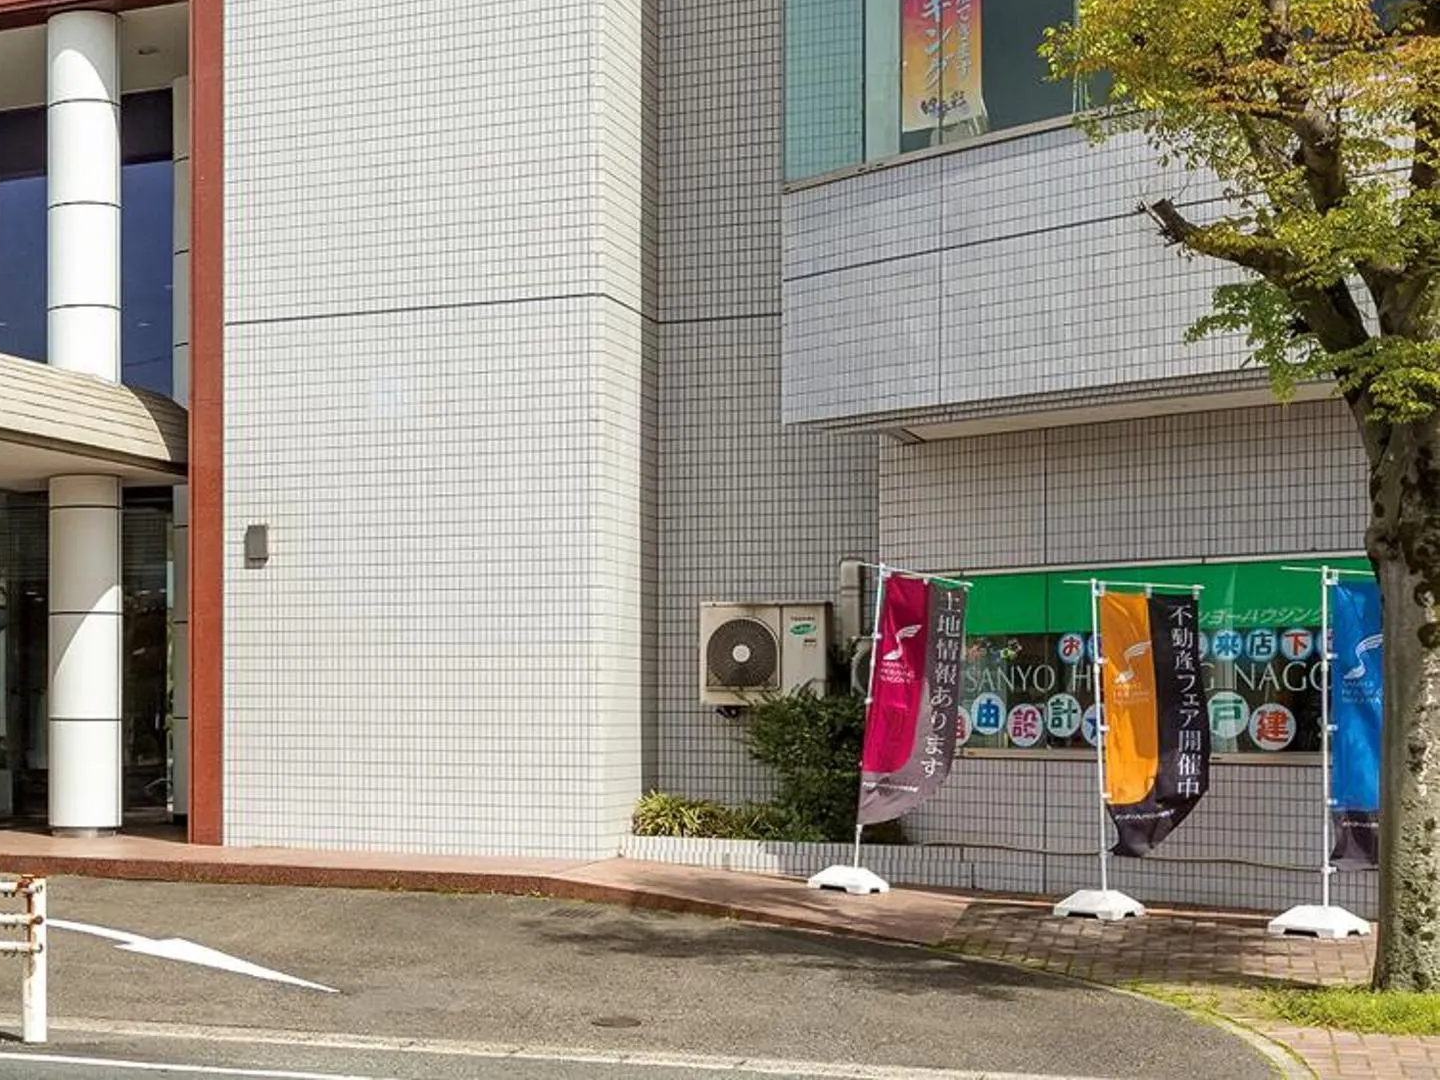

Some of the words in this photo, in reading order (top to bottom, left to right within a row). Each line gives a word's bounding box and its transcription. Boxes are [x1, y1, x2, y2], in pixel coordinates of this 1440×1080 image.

[920, 591, 961, 778] 土地情報あります
[965, 663, 1056, 693] SANYO
[1168, 604, 1203, 799] 不動産フェア開催中
